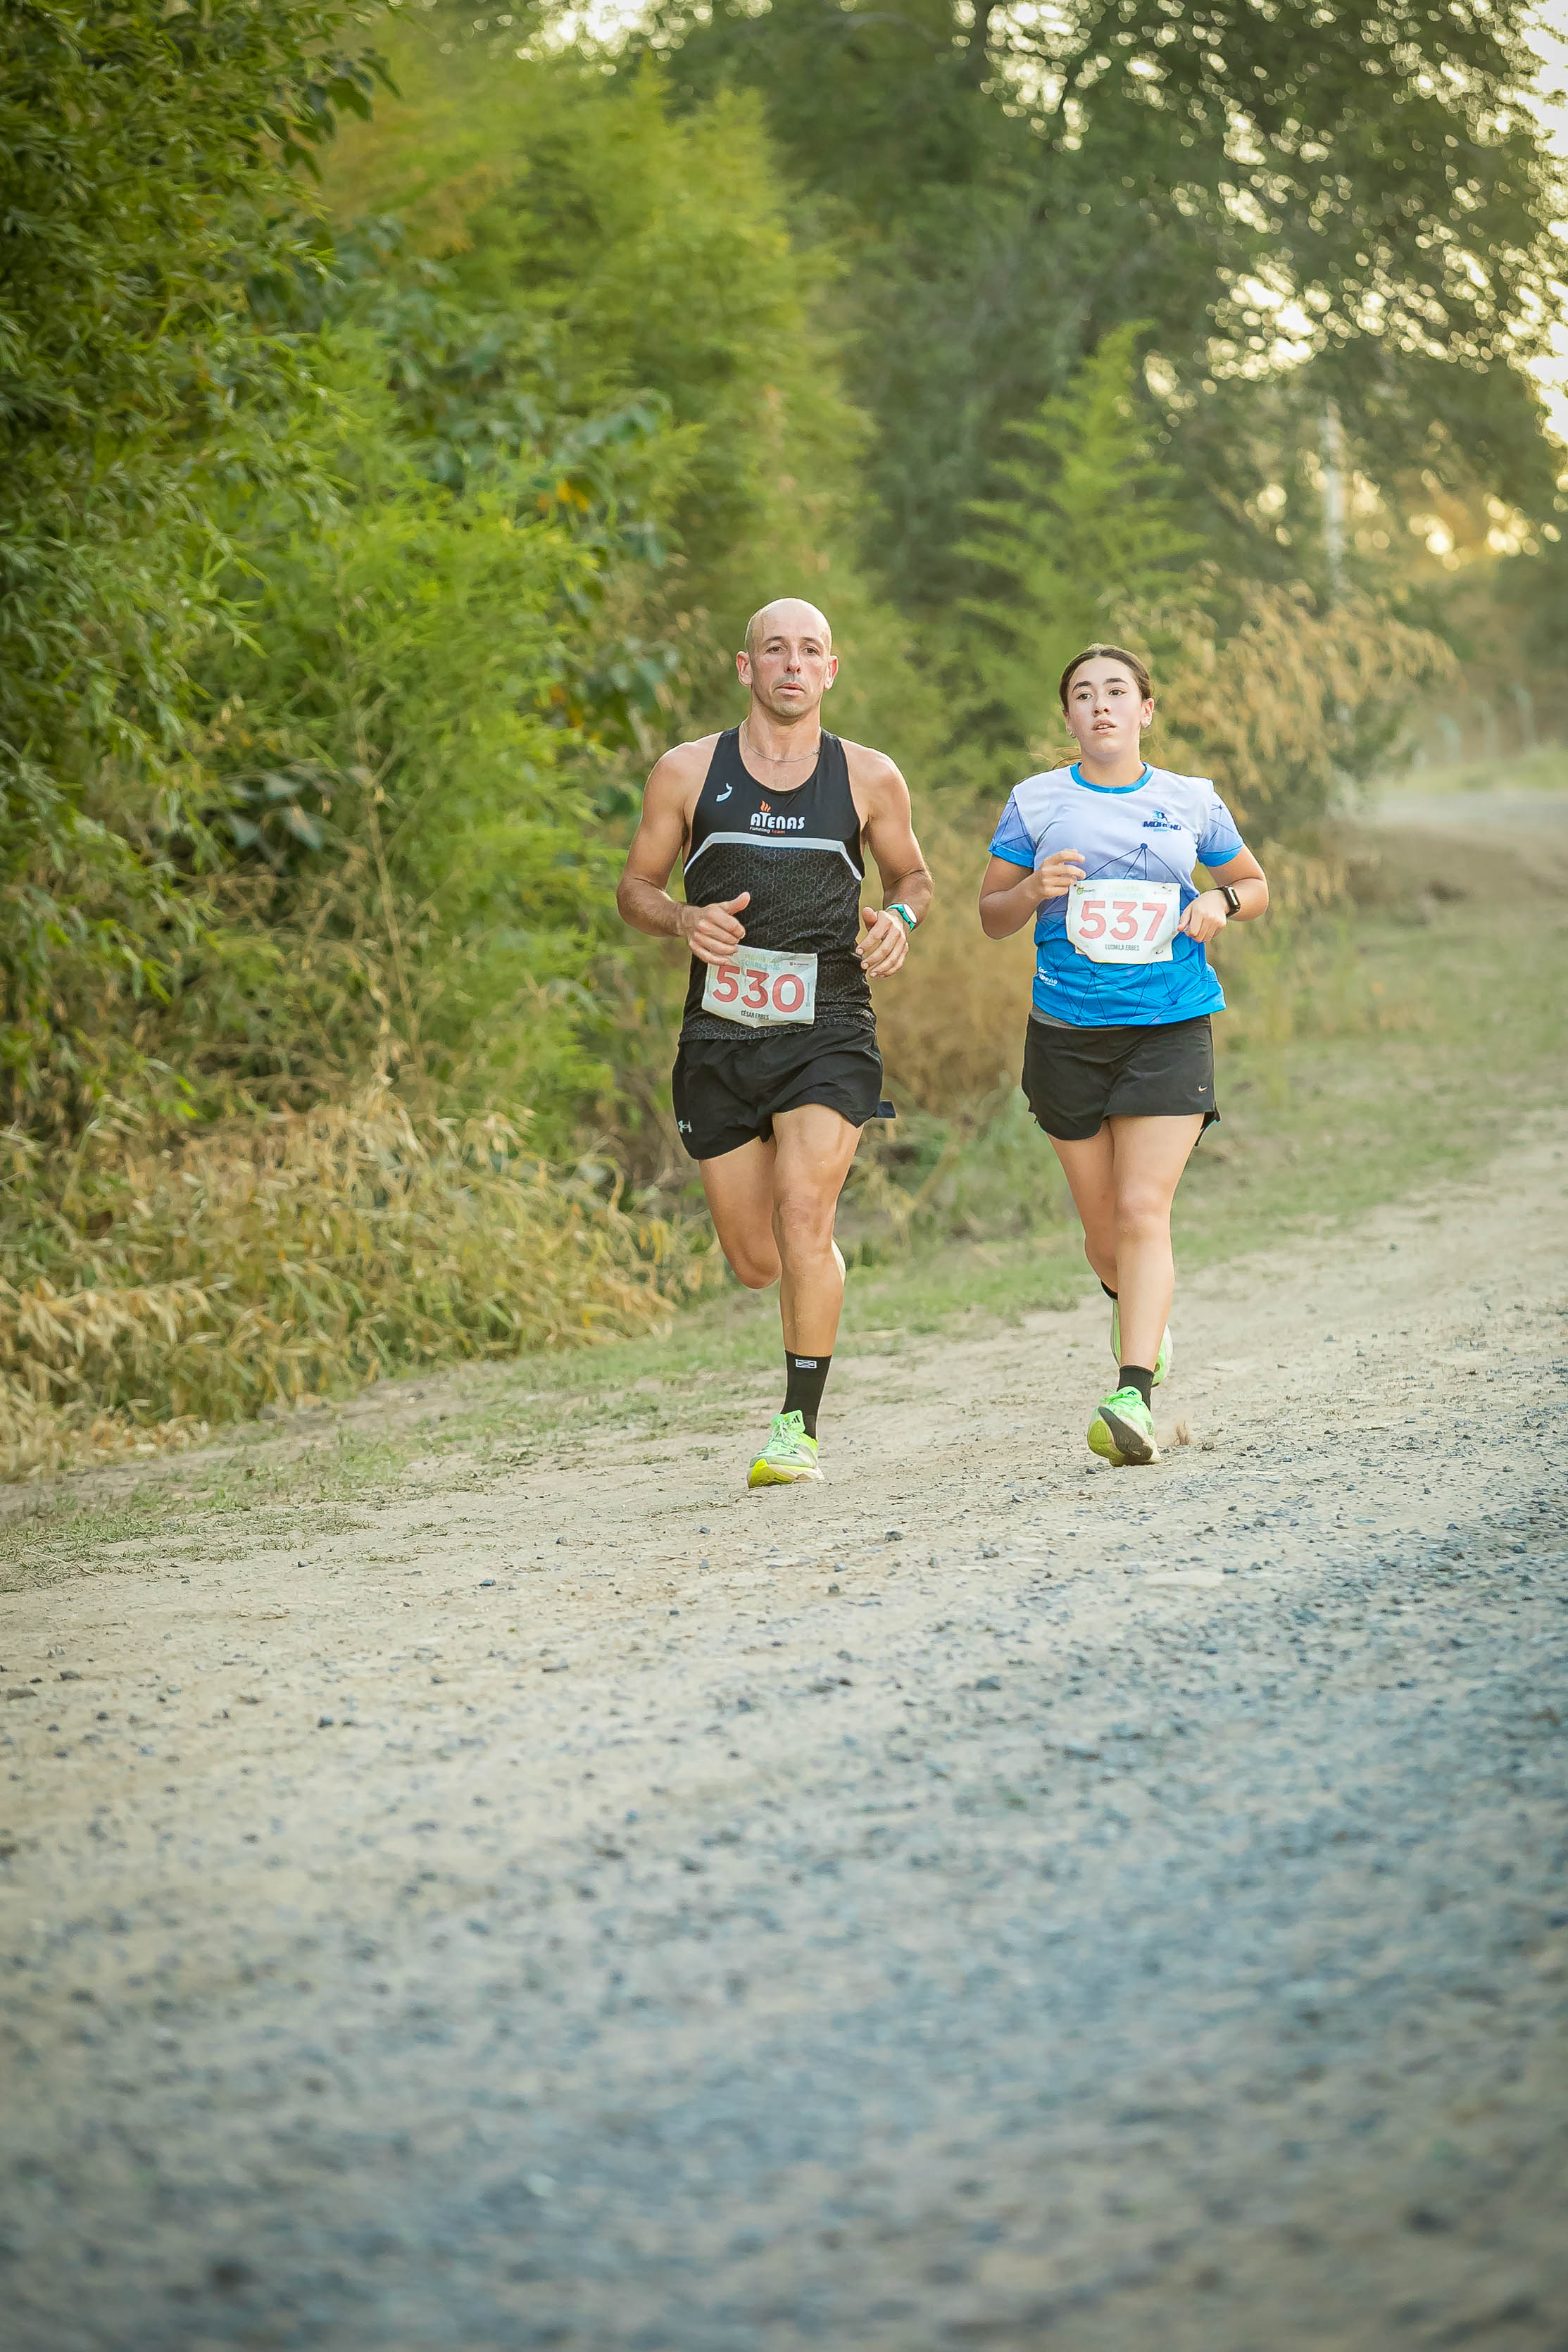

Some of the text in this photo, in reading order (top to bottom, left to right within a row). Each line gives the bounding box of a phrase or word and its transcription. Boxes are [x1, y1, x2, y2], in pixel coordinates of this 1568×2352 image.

[750, 811, 805, 830] ATENAS
[1079, 901, 1167, 941] 537
[713, 965, 805, 1013] 530
